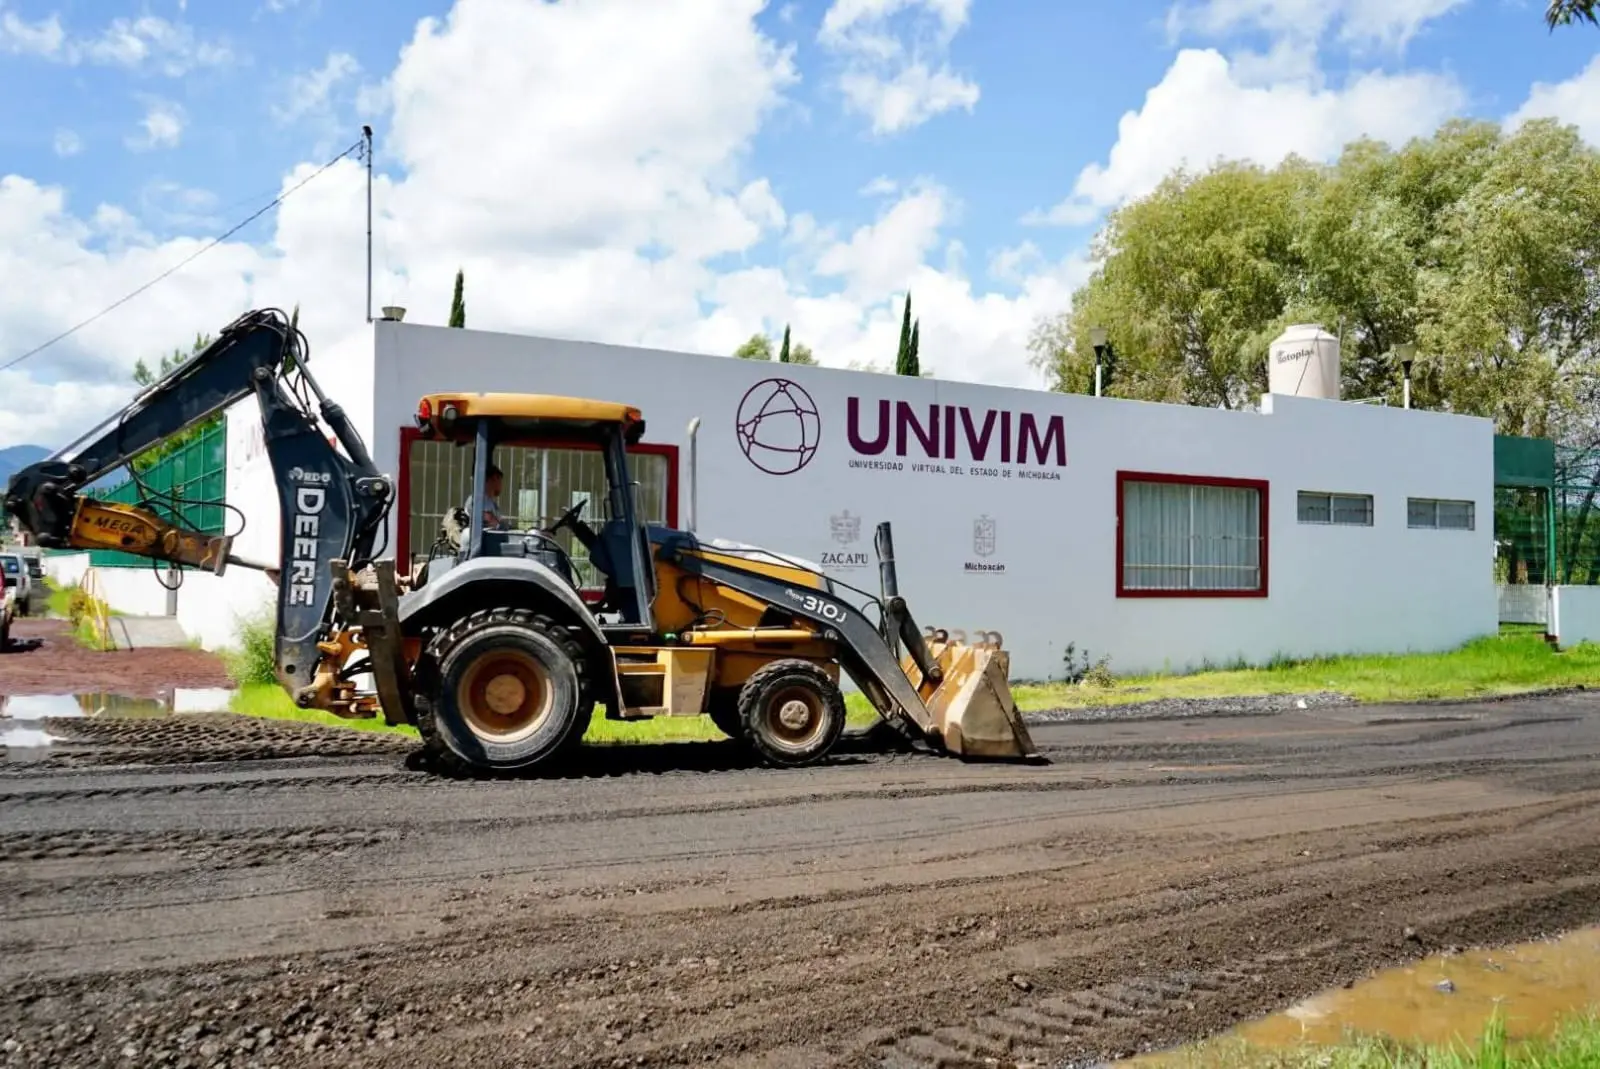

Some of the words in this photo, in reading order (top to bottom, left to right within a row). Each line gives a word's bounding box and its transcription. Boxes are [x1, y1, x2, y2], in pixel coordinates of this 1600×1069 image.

[847, 396, 1067, 467] UNIVIM
[848, 460, 904, 471] UNIVERSIDAD
[911, 463, 945, 474] VIRTUAL
[950, 466, 964, 475] DEL
[970, 467, 998, 477] ESTADO
[1002, 469, 1012, 478] DE
[1018, 470, 1061, 480] MICHOACÁN
[94, 516, 145, 534] MEGA
[289, 488, 326, 606] DEERE
[821, 552, 869, 565] ZACAPU
[964, 562, 1005, 571] Michoacán
[803, 595, 847, 623] 310J
